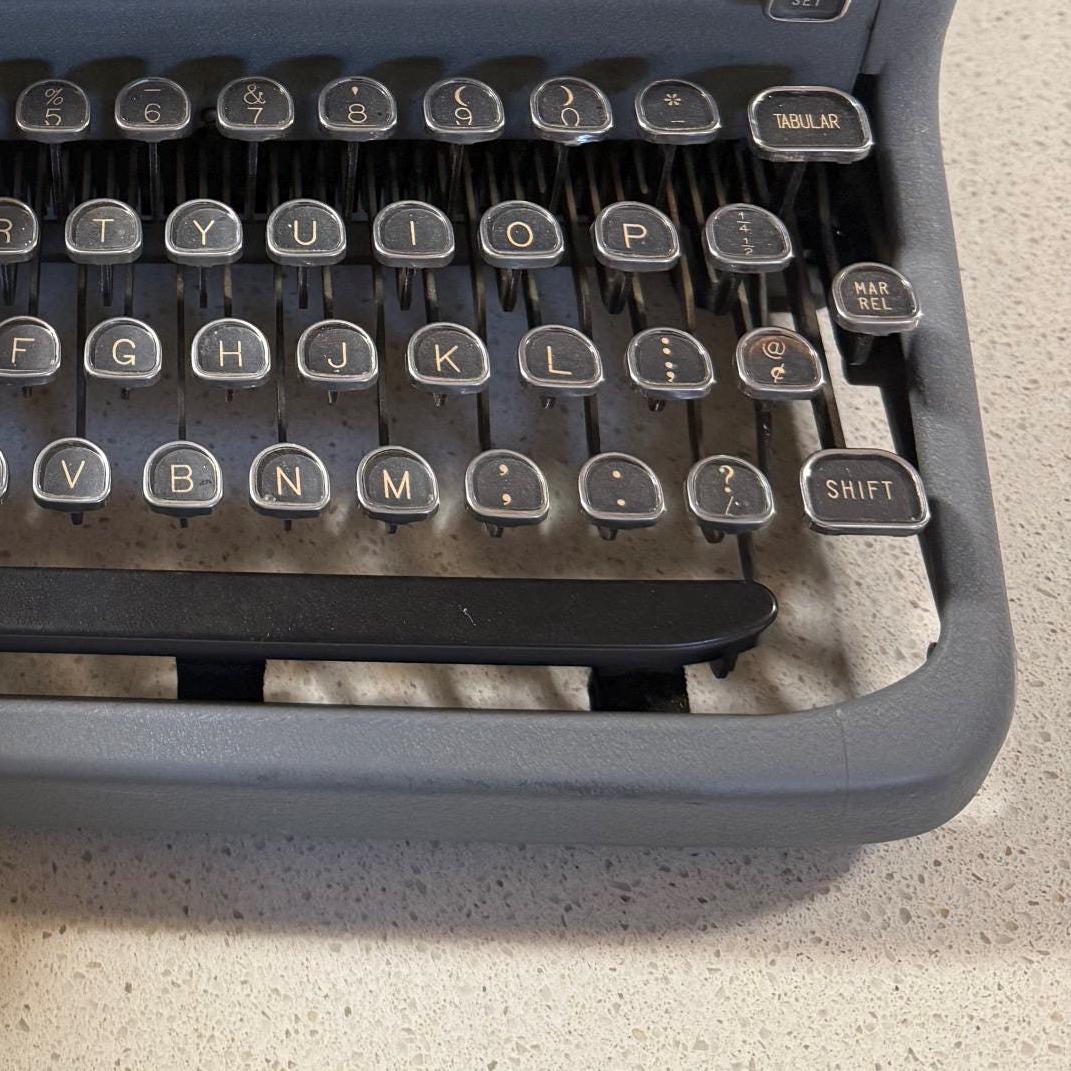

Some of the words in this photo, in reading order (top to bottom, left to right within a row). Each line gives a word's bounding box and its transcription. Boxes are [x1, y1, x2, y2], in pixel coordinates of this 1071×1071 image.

[44, 88, 64, 106] %
[243, 83, 266, 105] &
[560, 85, 574, 106] )
[44, 108, 62, 126] 5
[144, 103, 161, 123] 6
[247, 107, 263, 124] 7
[347, 103, 368, 124] 8
[455, 107, 472, 126] 9
[773, 113, 841, 129] TABULAR
[92, 218, 115, 243] T
[193, 219, 215, 245] Y
[293, 220, 317, 246] U
[506, 221, 533, 248] O
[622, 223, 647, 249] P
[854, 281, 889, 296] MAR
[856, 296, 892, 311] REL
[10, 337, 35, 364] F
[111, 338, 136, 366] G
[219, 340, 243, 367] H
[327, 341, 347, 368] J
[434, 343, 461, 372] K
[547, 345, 572, 375] L
[762, 341, 786, 359] @
[61, 459, 86, 489] V
[170, 464, 194, 494] B
[276, 466, 302, 496] N
[382, 469, 412, 500] M
[825, 479, 895, 501] SHIFT
